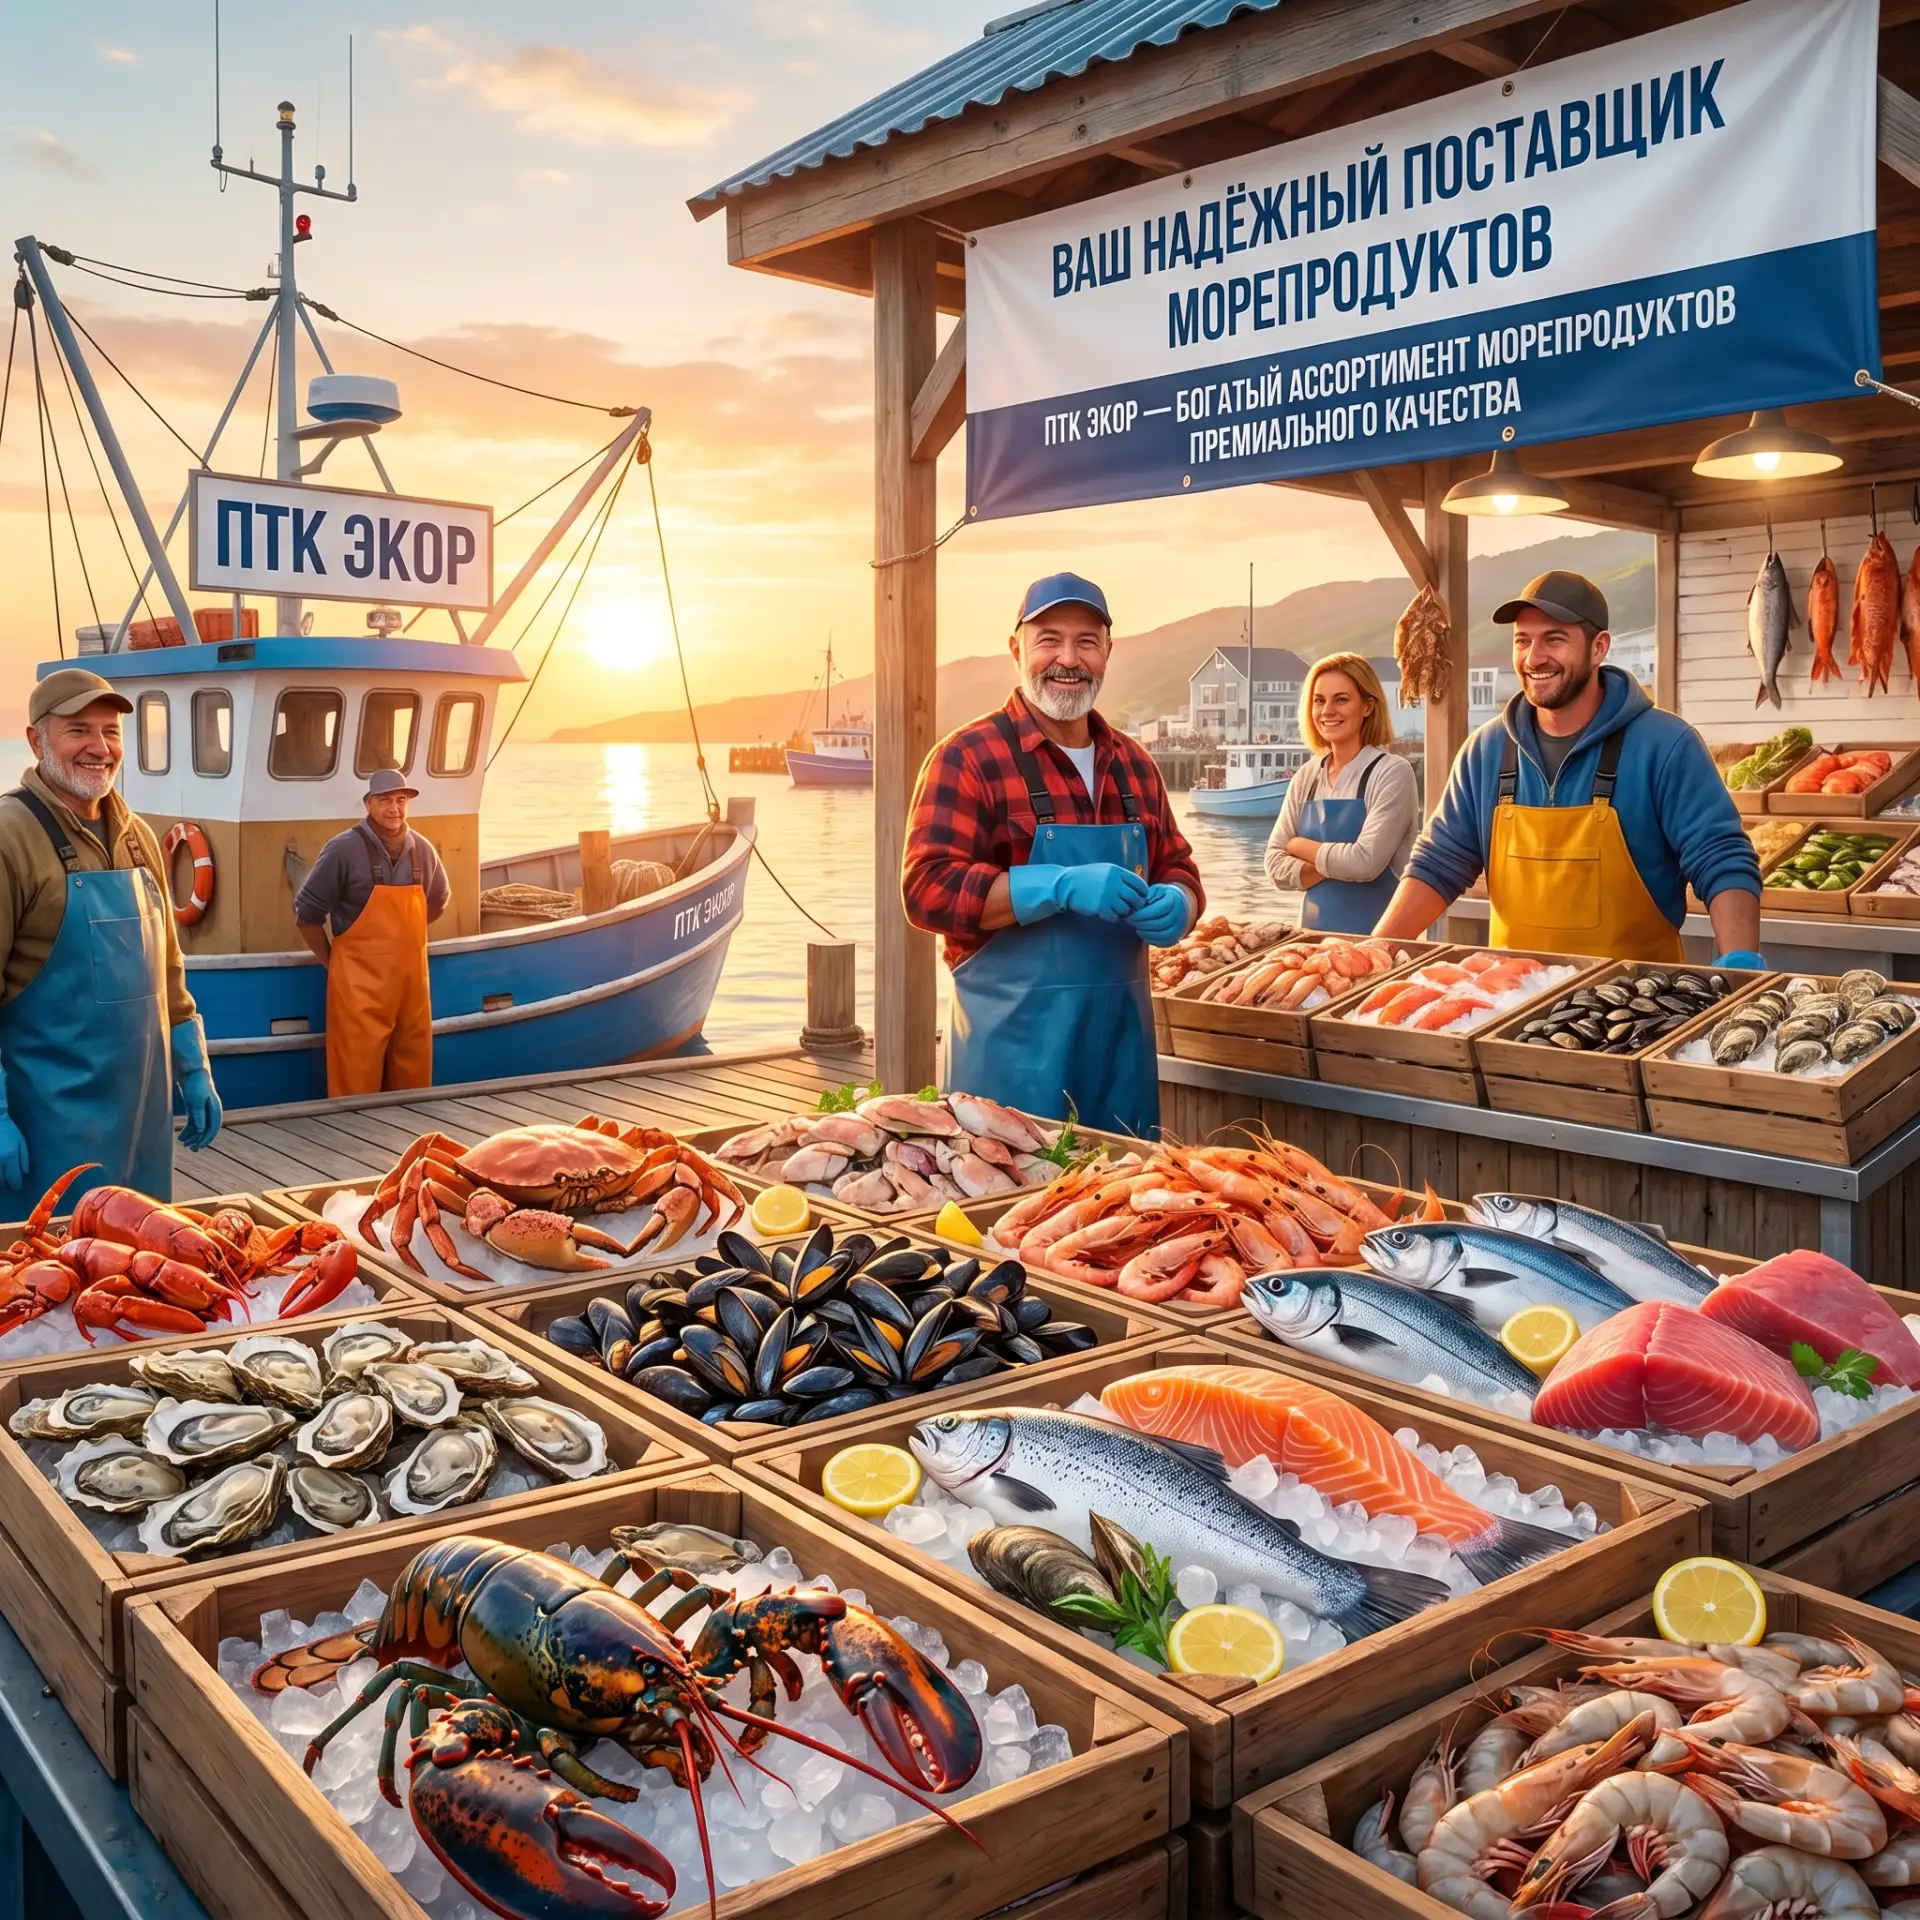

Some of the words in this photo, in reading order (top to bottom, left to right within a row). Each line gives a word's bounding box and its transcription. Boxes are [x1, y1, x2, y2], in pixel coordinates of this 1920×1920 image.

[1052, 225, 1131, 298] ВАШ
[1143, 142, 1388, 275] НАДЁЖНЫЙ
[1403, 57, 1726, 210] ПОСТАВЩИК
[1168, 205, 1552, 349] МОРЕПРОДУКТОВ
[1044, 410, 1082, 446] ПТК
[1087, 400, 1138, 438] ЭКОР
[1176, 364, 1282, 423] БОГАТЫЙ
[1288, 335, 1471, 403] АССОРТИМЕНТ
[1478, 284, 1736, 369] МОРЕПРОДУКТОВ
[1190, 401, 1378, 465] ПРЕМИАЛЬНОГО
[1385, 376, 1522, 433] КАЧЕСТВА
[217, 499, 327, 575] ПТК
[343, 514, 475, 586] ЭКОР
[673, 902, 701, 940] ПТК
